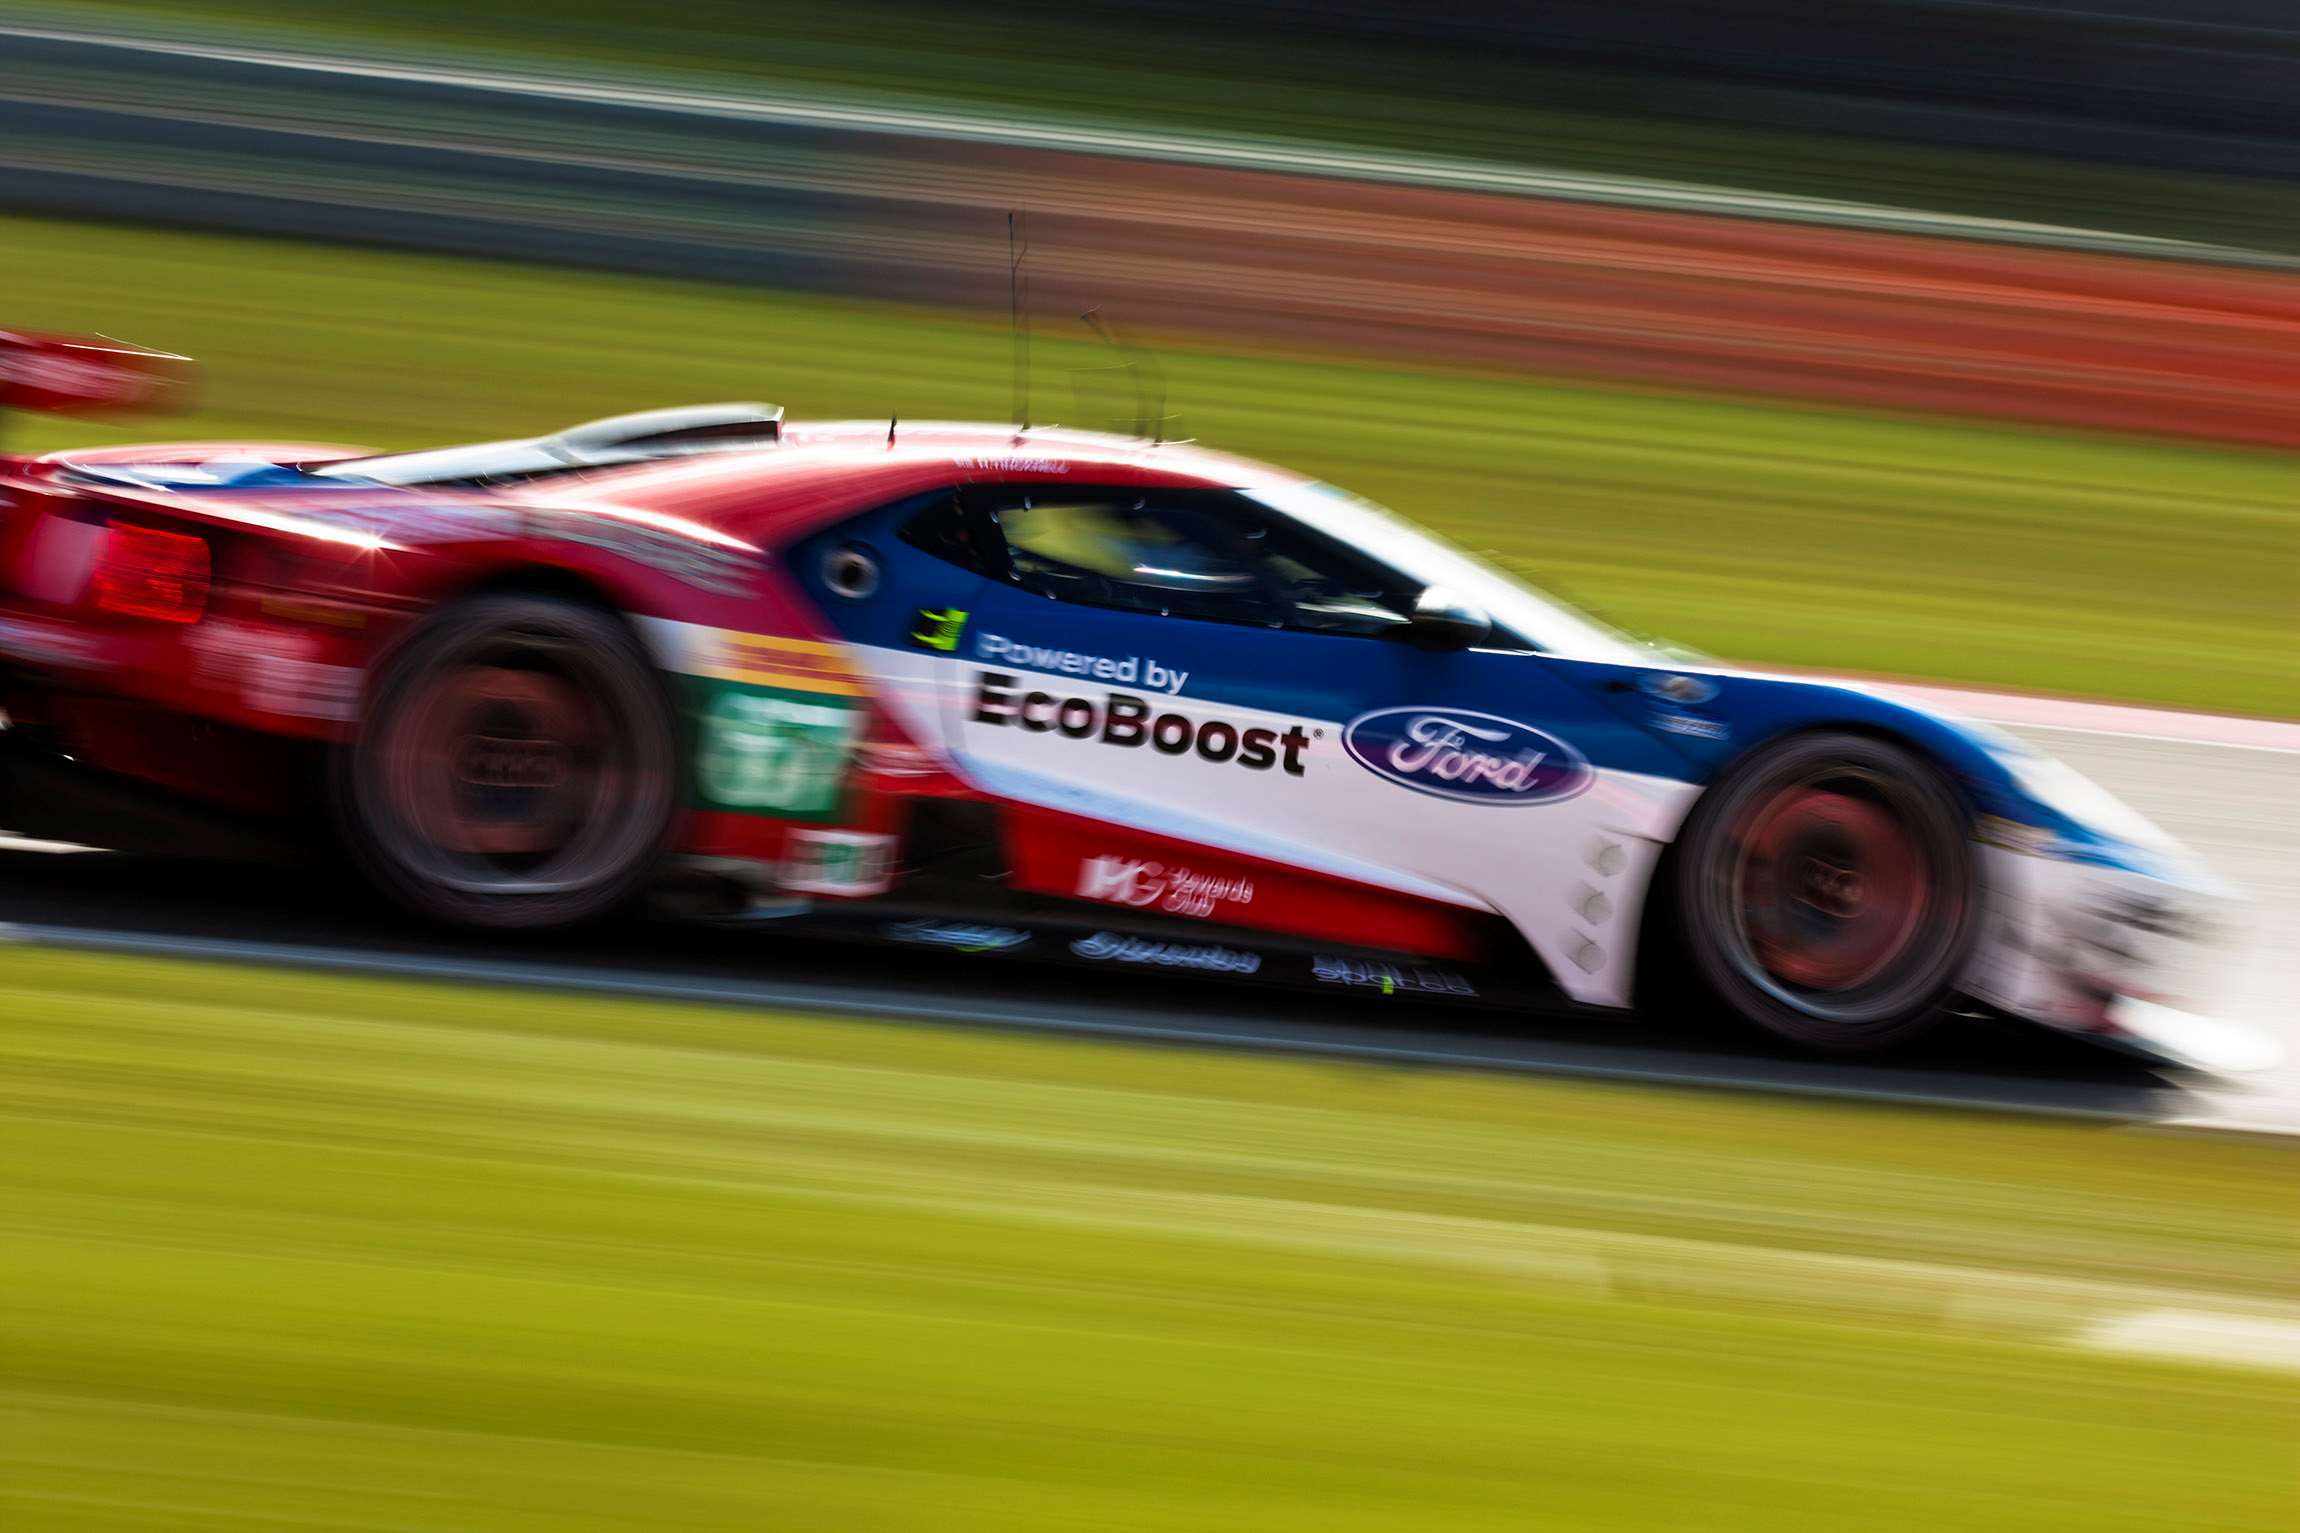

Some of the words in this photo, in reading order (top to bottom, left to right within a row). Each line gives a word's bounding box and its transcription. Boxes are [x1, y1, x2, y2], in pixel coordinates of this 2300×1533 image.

[976, 630, 1139, 685] Powered
[1144, 658, 1190, 696] by
[1388, 714, 1548, 793] Ford
